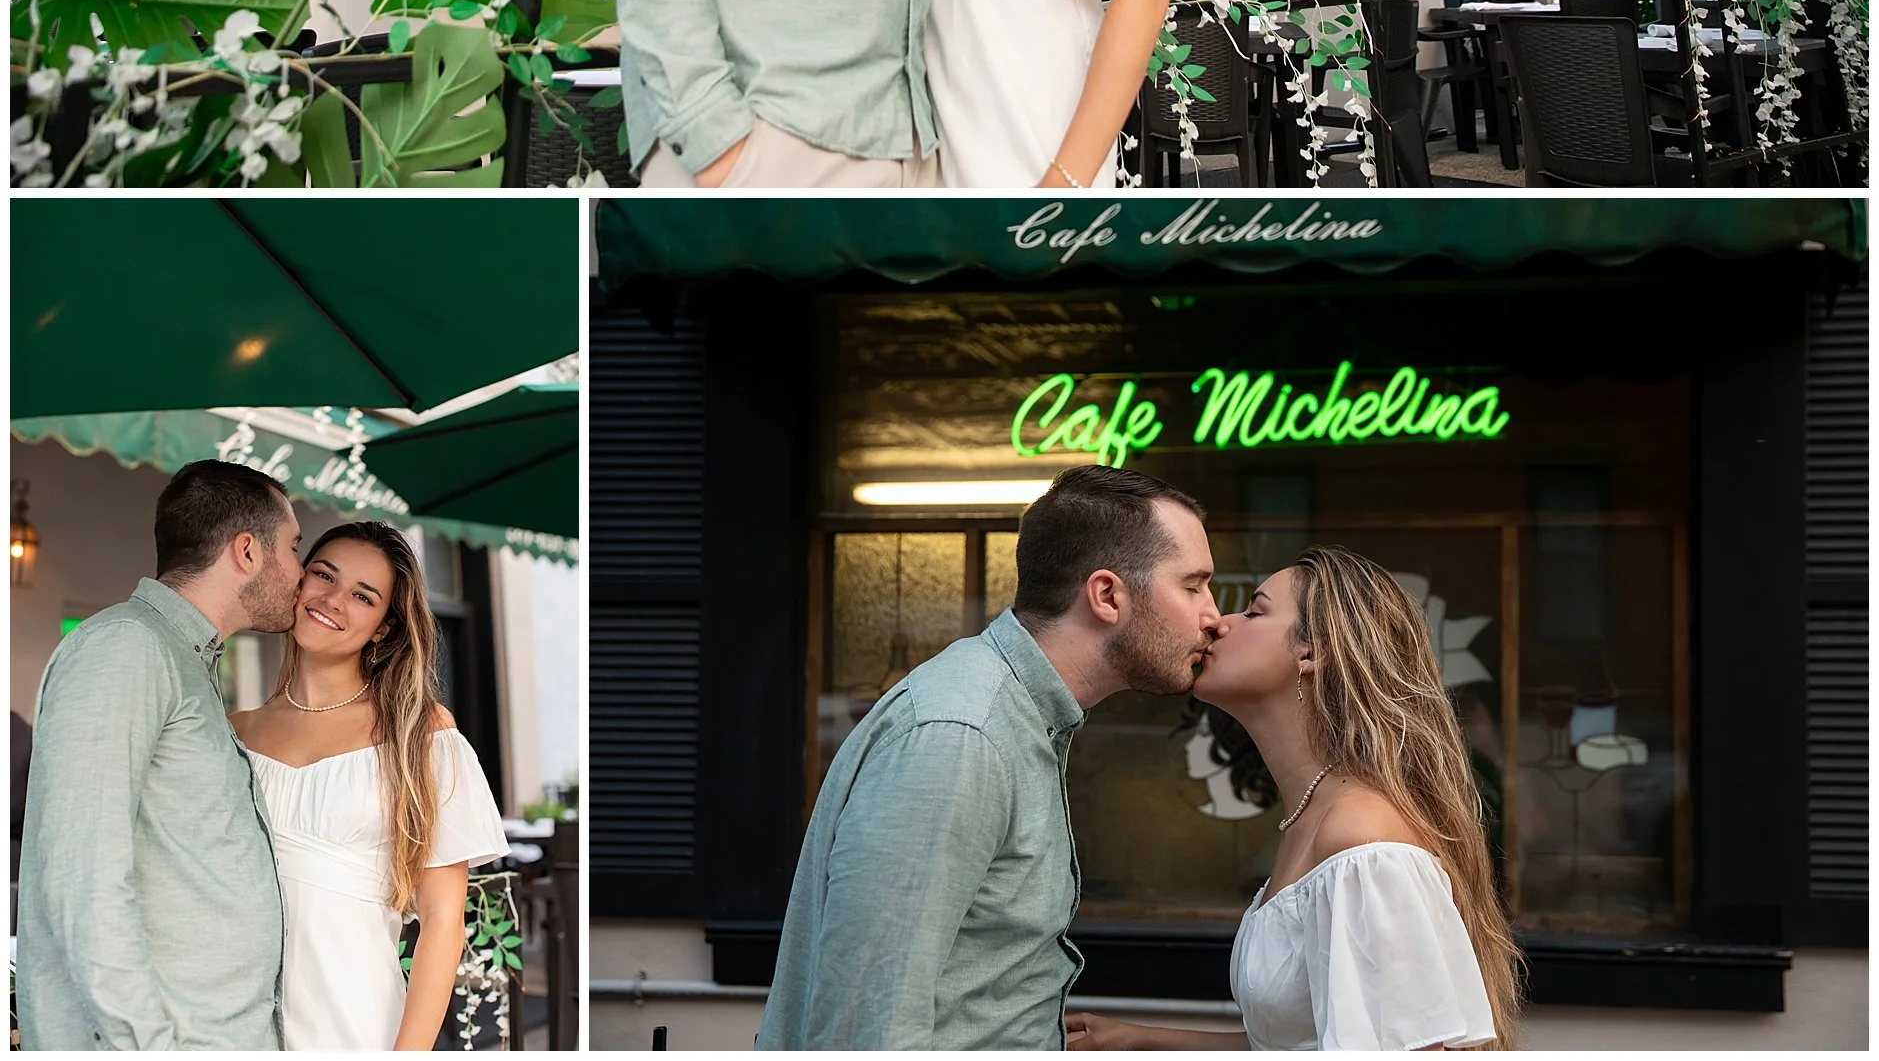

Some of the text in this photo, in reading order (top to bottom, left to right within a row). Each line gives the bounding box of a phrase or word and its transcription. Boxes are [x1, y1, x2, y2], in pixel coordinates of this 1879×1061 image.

[1007, 198, 1384, 264] Cafe Michelina
[1010, 361, 1510, 470] Cafe Michelina
